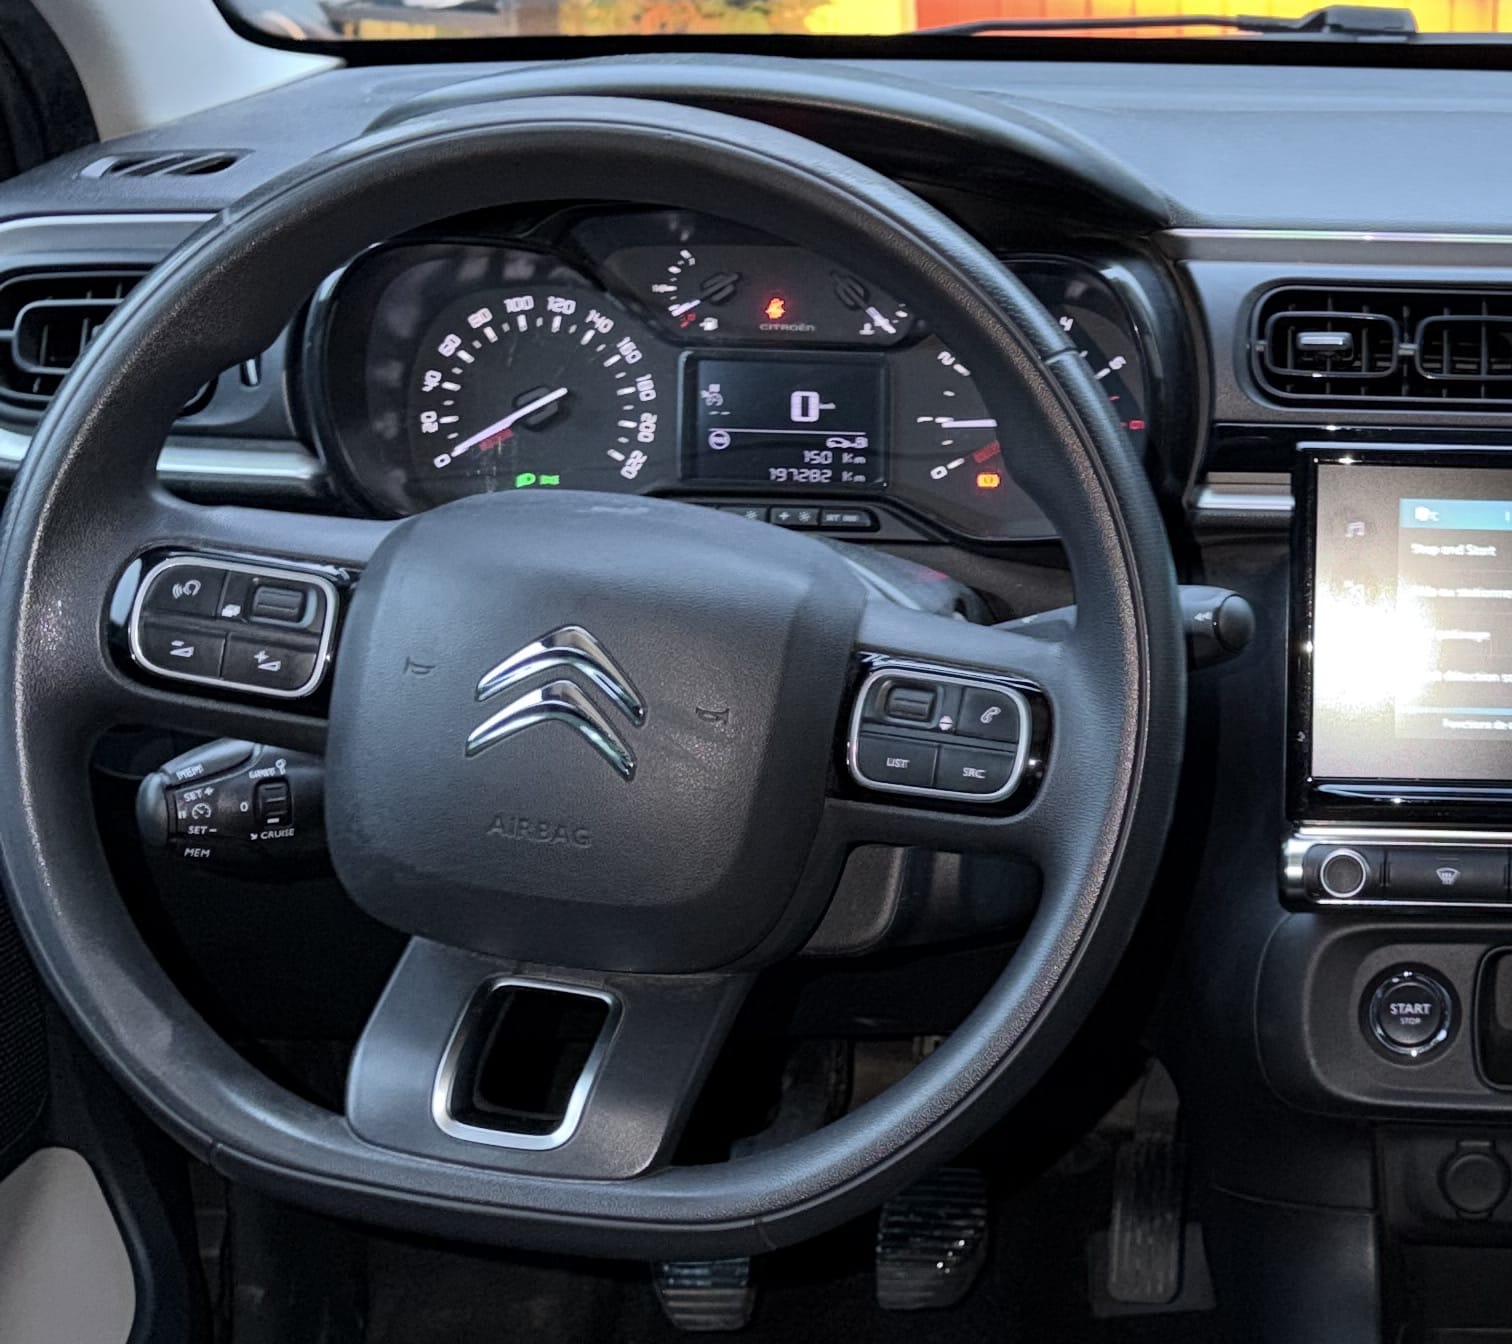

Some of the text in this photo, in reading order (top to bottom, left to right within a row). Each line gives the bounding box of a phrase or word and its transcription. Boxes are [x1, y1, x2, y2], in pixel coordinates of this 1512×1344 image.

[503, 295, 535, 314] 100
[547, 295, 577, 316] 120
[585, 309, 615, 334] 140
[937, 350, 956, 366] 2
[421, 369, 443, 393] 40
[420, 410, 439, 434] 20
[636, 412, 658, 444] 200
[433, 453, 451, 469] 0
[803, 450, 833, 464] 150
[768, 467, 833, 483] 197282
[930, 465, 948, 480] 0
[1410, 542, 1497, 557] Stop and Start
[886, 757, 911, 769] LIST
[962, 767, 988, 779] SRC
[260, 827, 295, 840] CRUISE
[486, 814, 593, 849] AIRBAG
[184, 848, 211, 858] MEM
[1390, 1002, 1432, 1015] START
[1400, 1017, 1422, 1025] STOP
